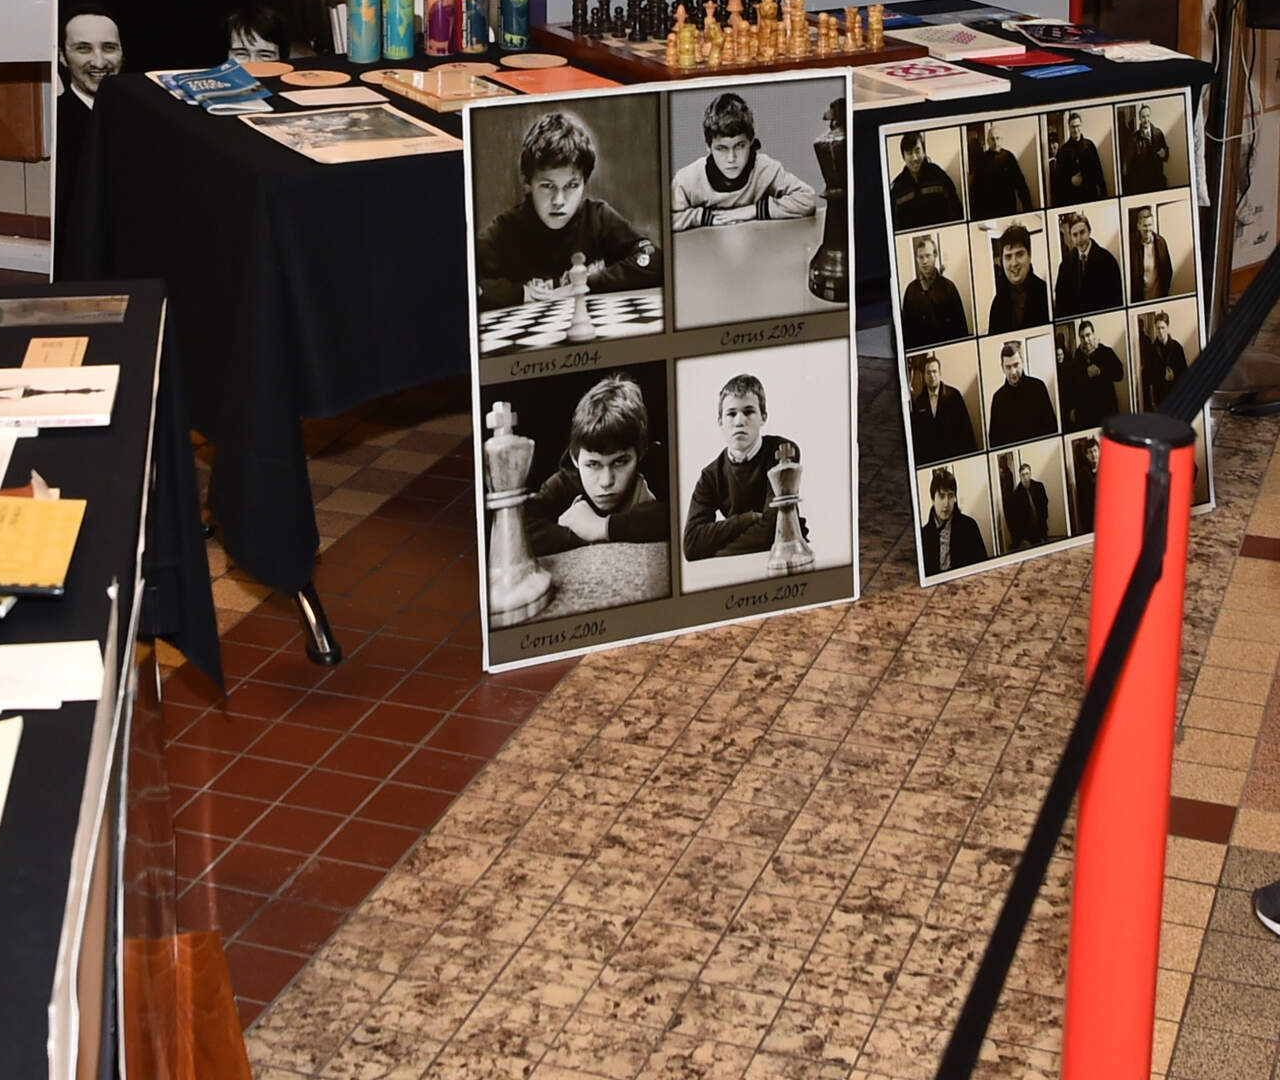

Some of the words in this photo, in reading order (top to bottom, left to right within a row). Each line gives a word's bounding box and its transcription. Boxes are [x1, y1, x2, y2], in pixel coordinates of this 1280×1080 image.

[720, 329, 765, 347] Corus
[767, 321, 806, 343] 2005
[510, 354, 557, 377] Corus
[559, 350, 602, 372] 2004
[725, 591, 769, 611] Corus
[771, 582, 809, 603] 2007
[520, 631, 566, 651] Corus
[569, 620, 607, 642] 2006
